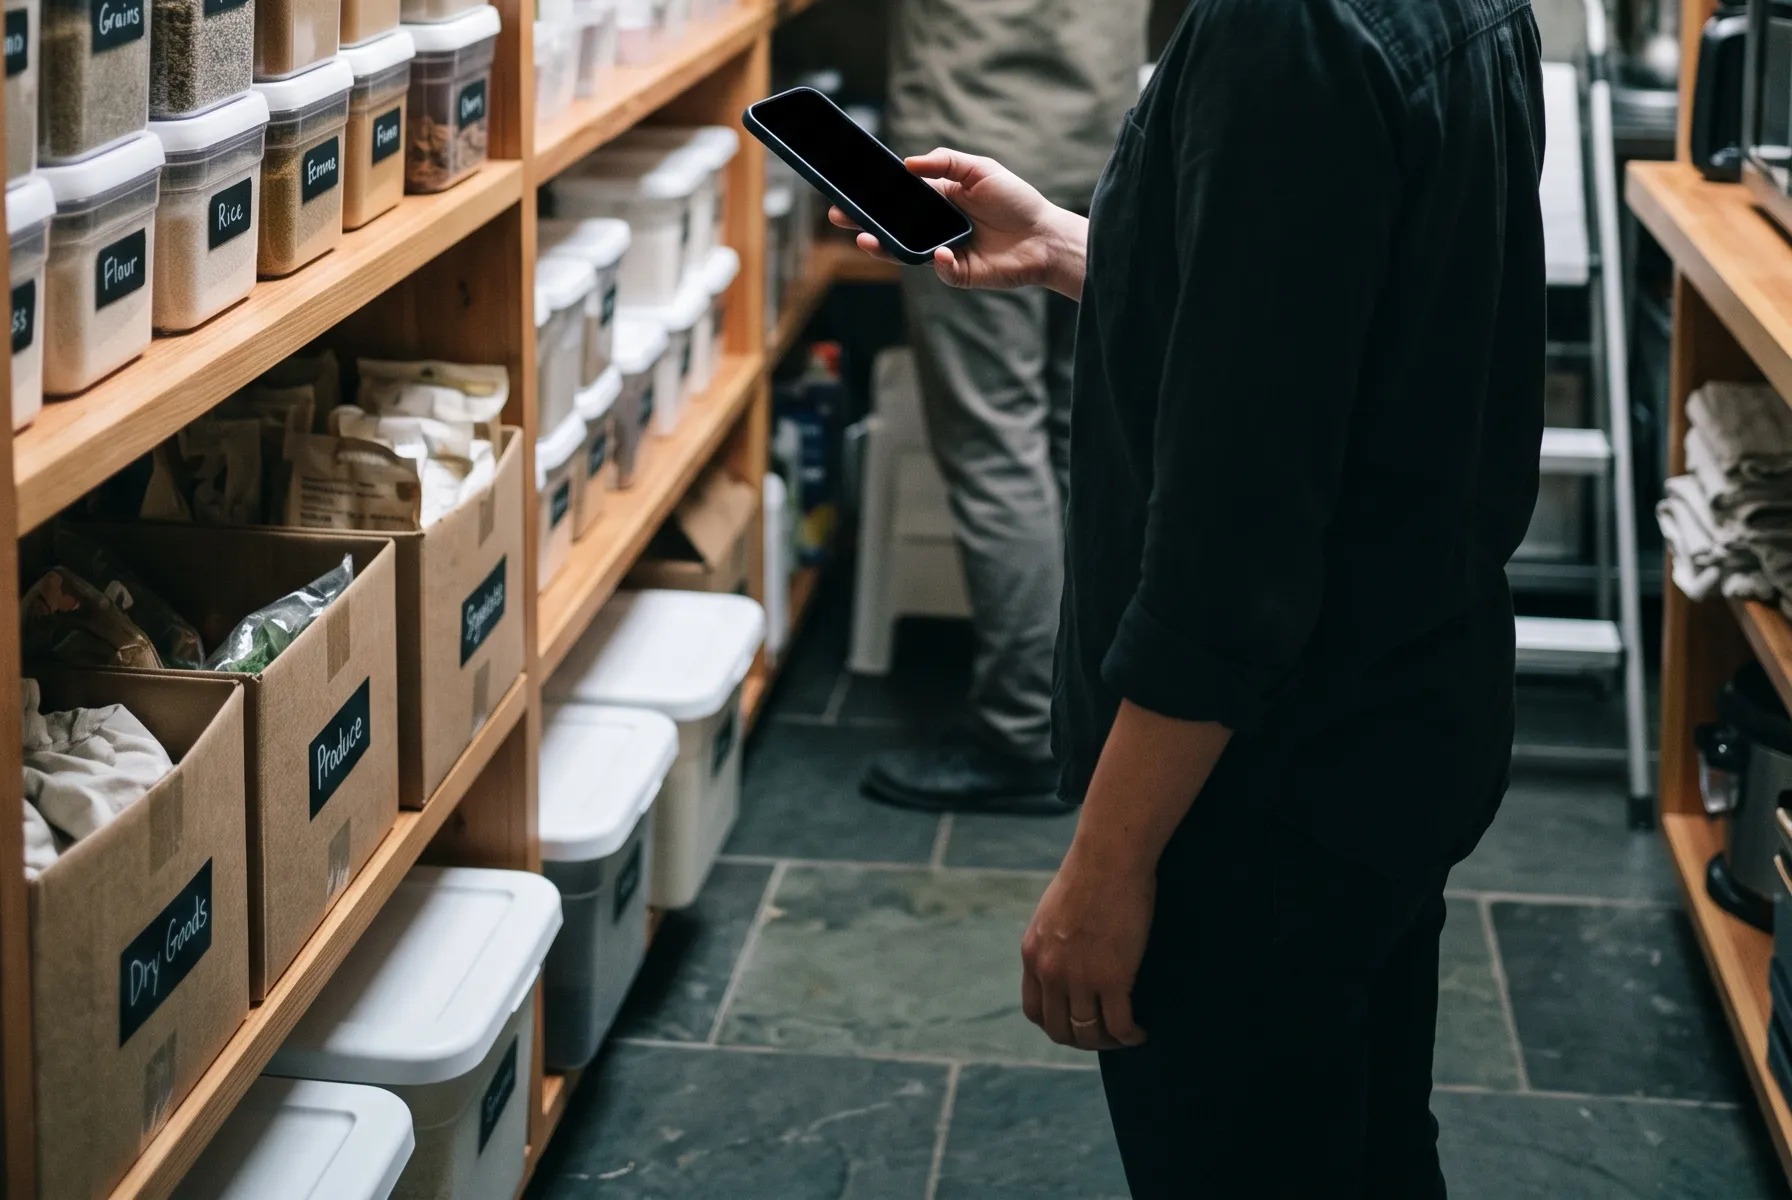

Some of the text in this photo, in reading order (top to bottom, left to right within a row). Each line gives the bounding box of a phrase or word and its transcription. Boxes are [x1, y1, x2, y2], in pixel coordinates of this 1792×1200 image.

[99, 3, 139, 35] Grains
[219, 203, 243, 230] Rice
[104, 256, 138, 290] Flour
[317, 716, 361, 790] Produce
[130, 895, 207, 1006] Dry Goods
